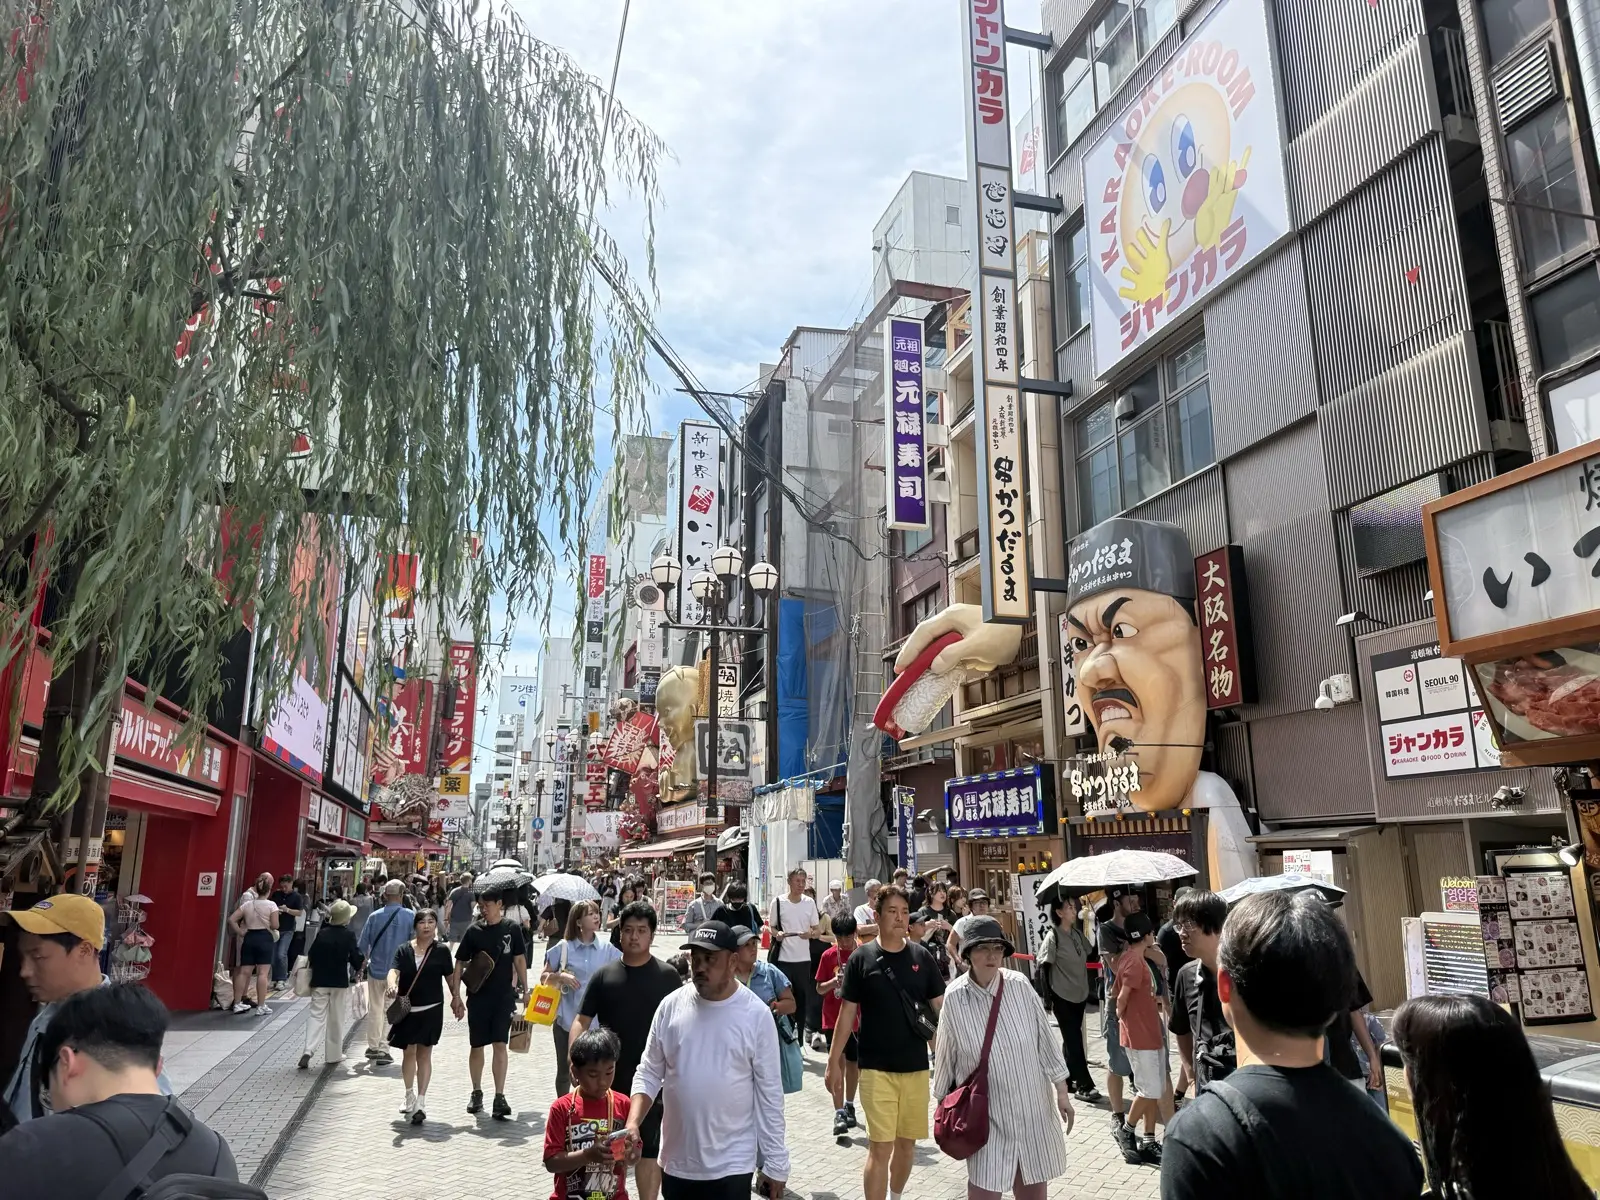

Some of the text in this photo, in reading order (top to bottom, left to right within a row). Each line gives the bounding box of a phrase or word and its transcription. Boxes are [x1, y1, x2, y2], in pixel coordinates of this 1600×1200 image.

[1119, 216, 1248, 352] ジャンカラ
[895, 338, 918, 352] 元祖
[990, 286, 1009, 373] 創業昭和四年
[691, 431, 713, 479] 新世界
[895, 380, 922, 499] 元禄寿司
[994, 455, 1022, 602] 串かつだるま
[1202, 560, 1233, 699] 大阪名物
[1424, 674, 1459, 688] SEOUL 90
[1388, 726, 1465, 755] ジャンカラ
[1396, 756, 1419, 764] KARAOKE
[1450, 751, 1467, 759] DRINK
[445, 777, 461, 792] 薬
[584, 743, 608, 813] 大阪王
[1070, 761, 1142, 803] 串かつだるま
[979, 785, 1035, 818] 元禄寿司
[1442, 878, 1476, 888] Welcom
[511, 1020, 529, 1032] NIK
